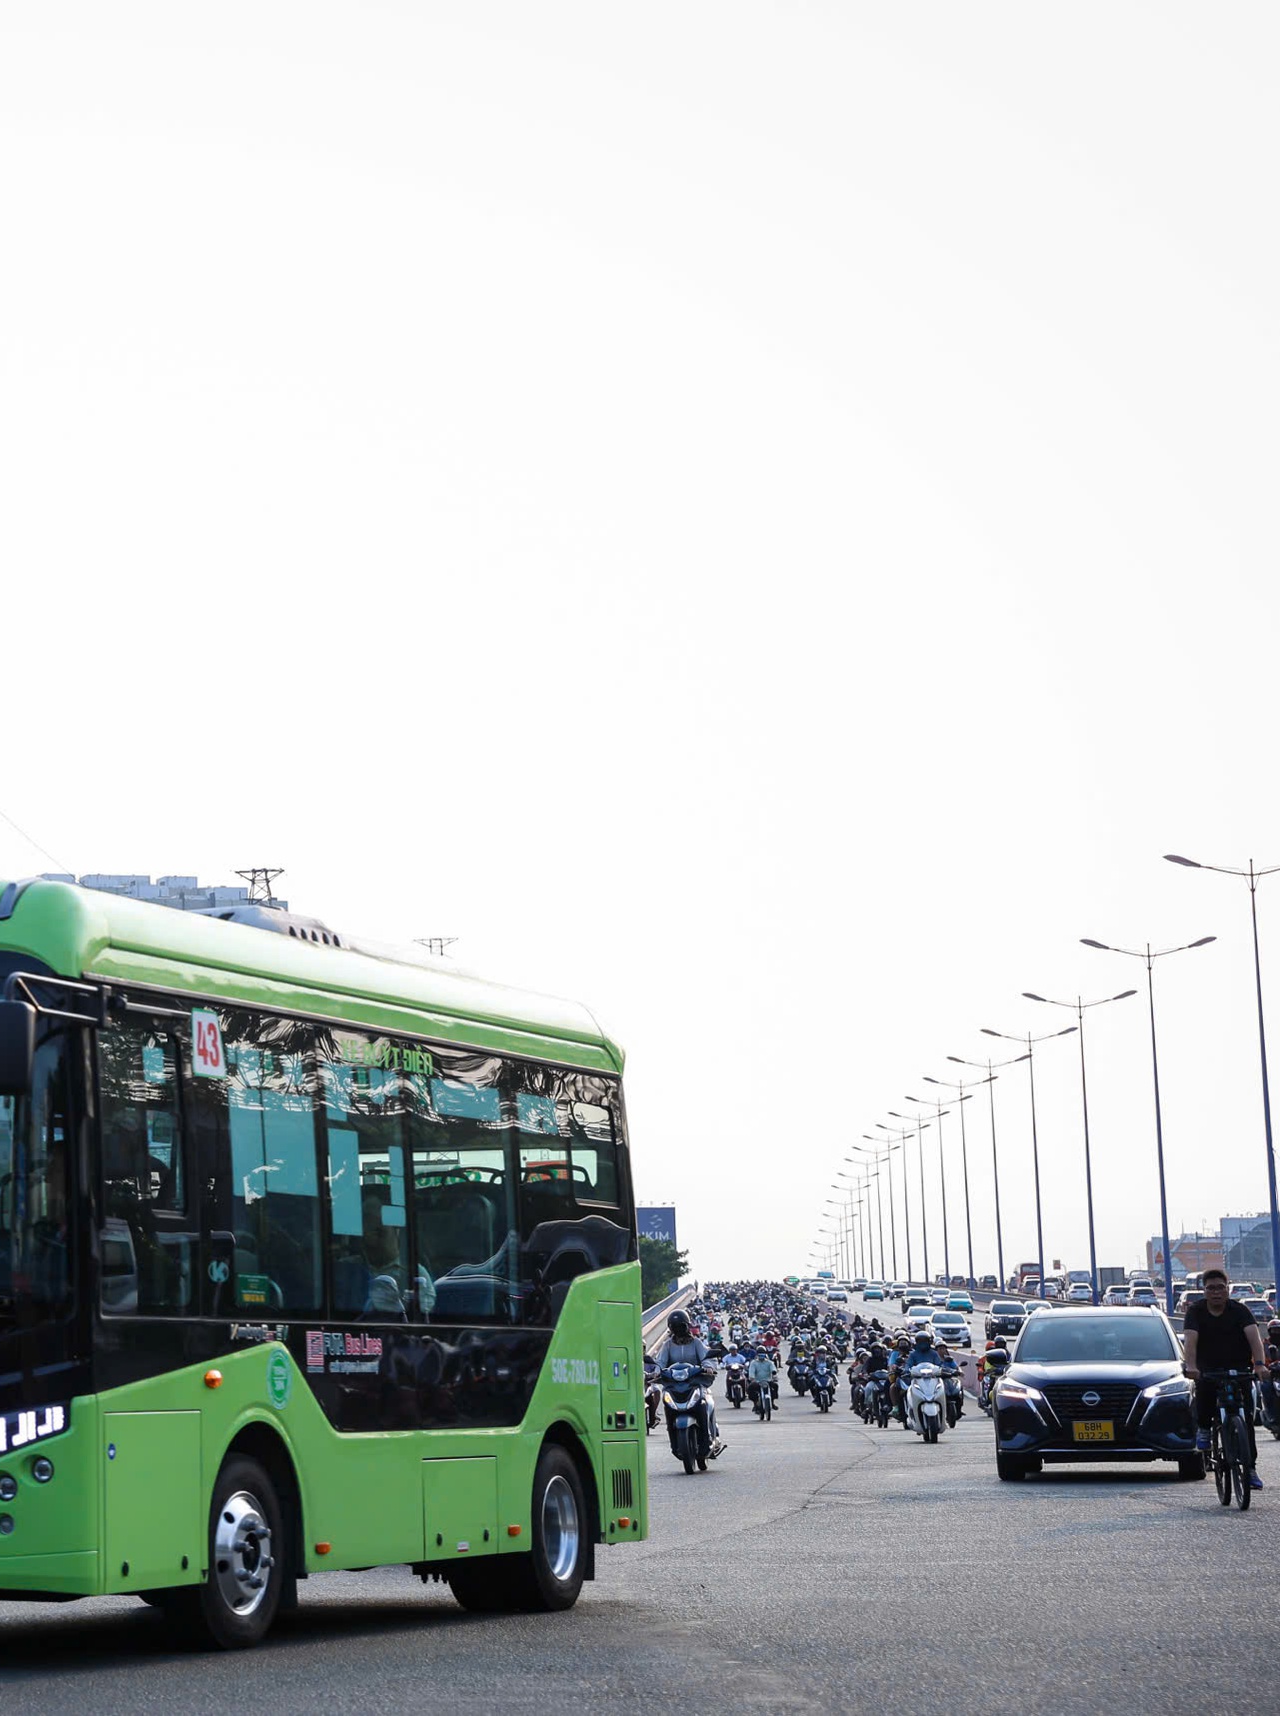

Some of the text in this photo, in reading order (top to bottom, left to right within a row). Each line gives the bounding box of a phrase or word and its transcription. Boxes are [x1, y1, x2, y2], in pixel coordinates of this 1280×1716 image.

[196, 1021, 220, 1067] 43
[1084, 1422, 1102, 1431] 68H
[1078, 1432, 1110, 1440] 032.29
